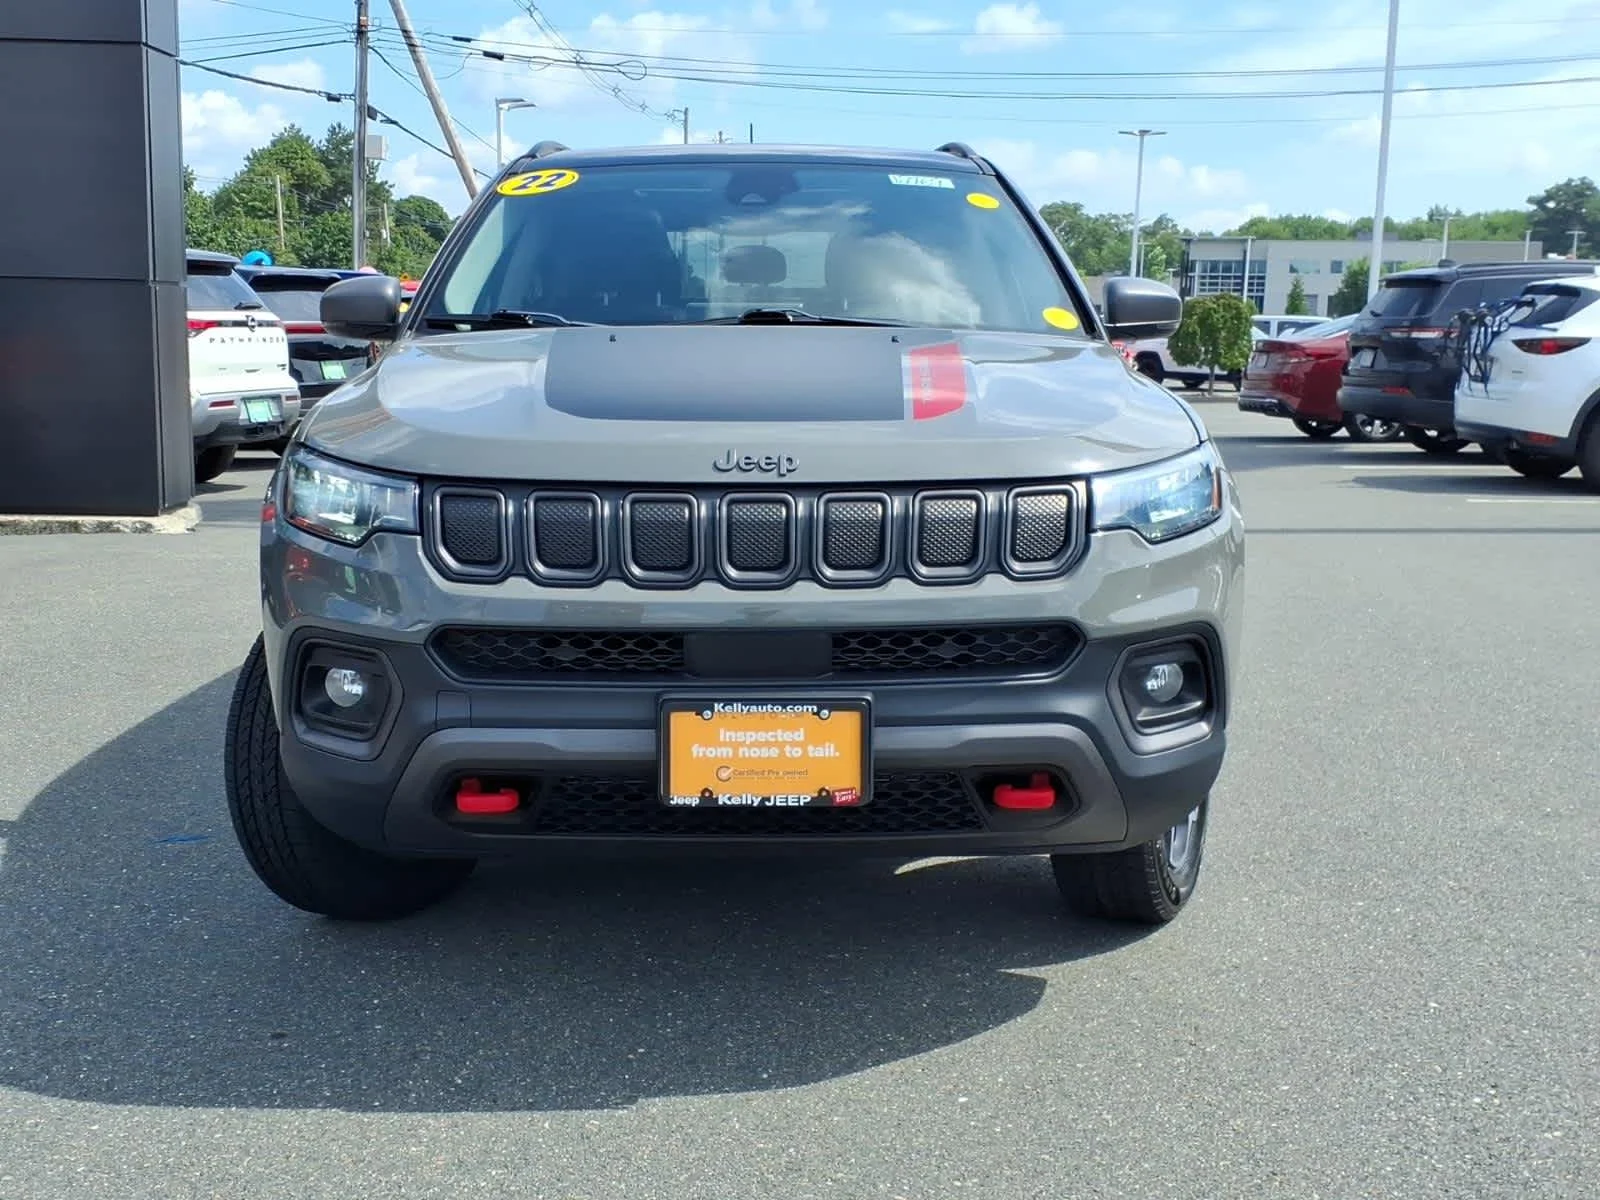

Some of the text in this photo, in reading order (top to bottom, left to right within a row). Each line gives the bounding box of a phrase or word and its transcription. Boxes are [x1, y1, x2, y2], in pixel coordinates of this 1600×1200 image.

[511, 172, 568, 191] 22
[712, 447, 800, 477] Jeep
[713, 702, 818, 714] Kellyauto.com
[719, 728, 805, 744] Inspected
[691, 743, 840, 758] from nose to tail.
[669, 795, 700, 806] Jeep
[718, 793, 812, 806] Kelly JEEP
